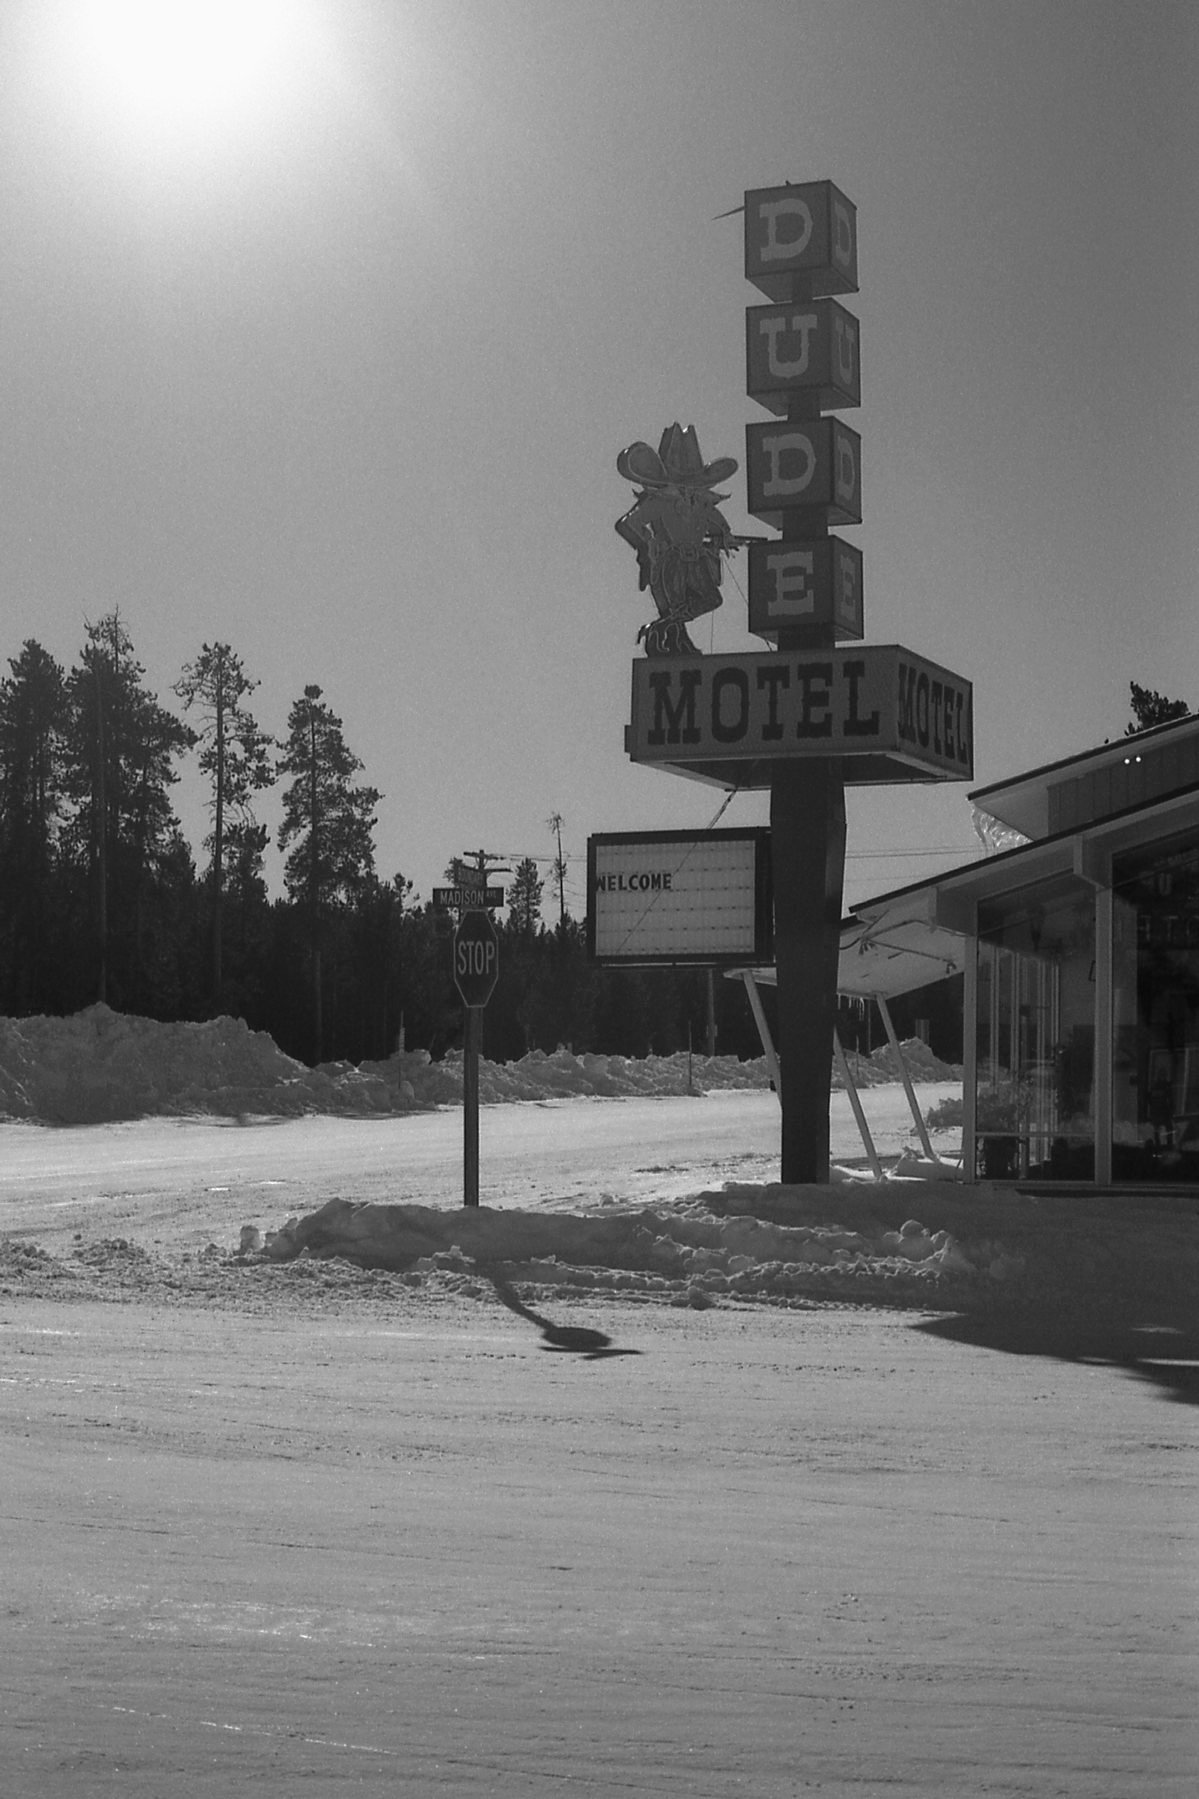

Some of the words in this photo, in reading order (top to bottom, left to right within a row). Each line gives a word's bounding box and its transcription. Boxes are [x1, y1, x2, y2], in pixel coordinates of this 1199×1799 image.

[759, 198, 819, 616] DUDE
[837, 205, 856, 621] DUDE
[648, 661, 880, 745] MOTEL
[898, 663, 969, 764] MOTEL
[440, 889, 484, 904] MADISON
[457, 936, 495, 975] STOP
